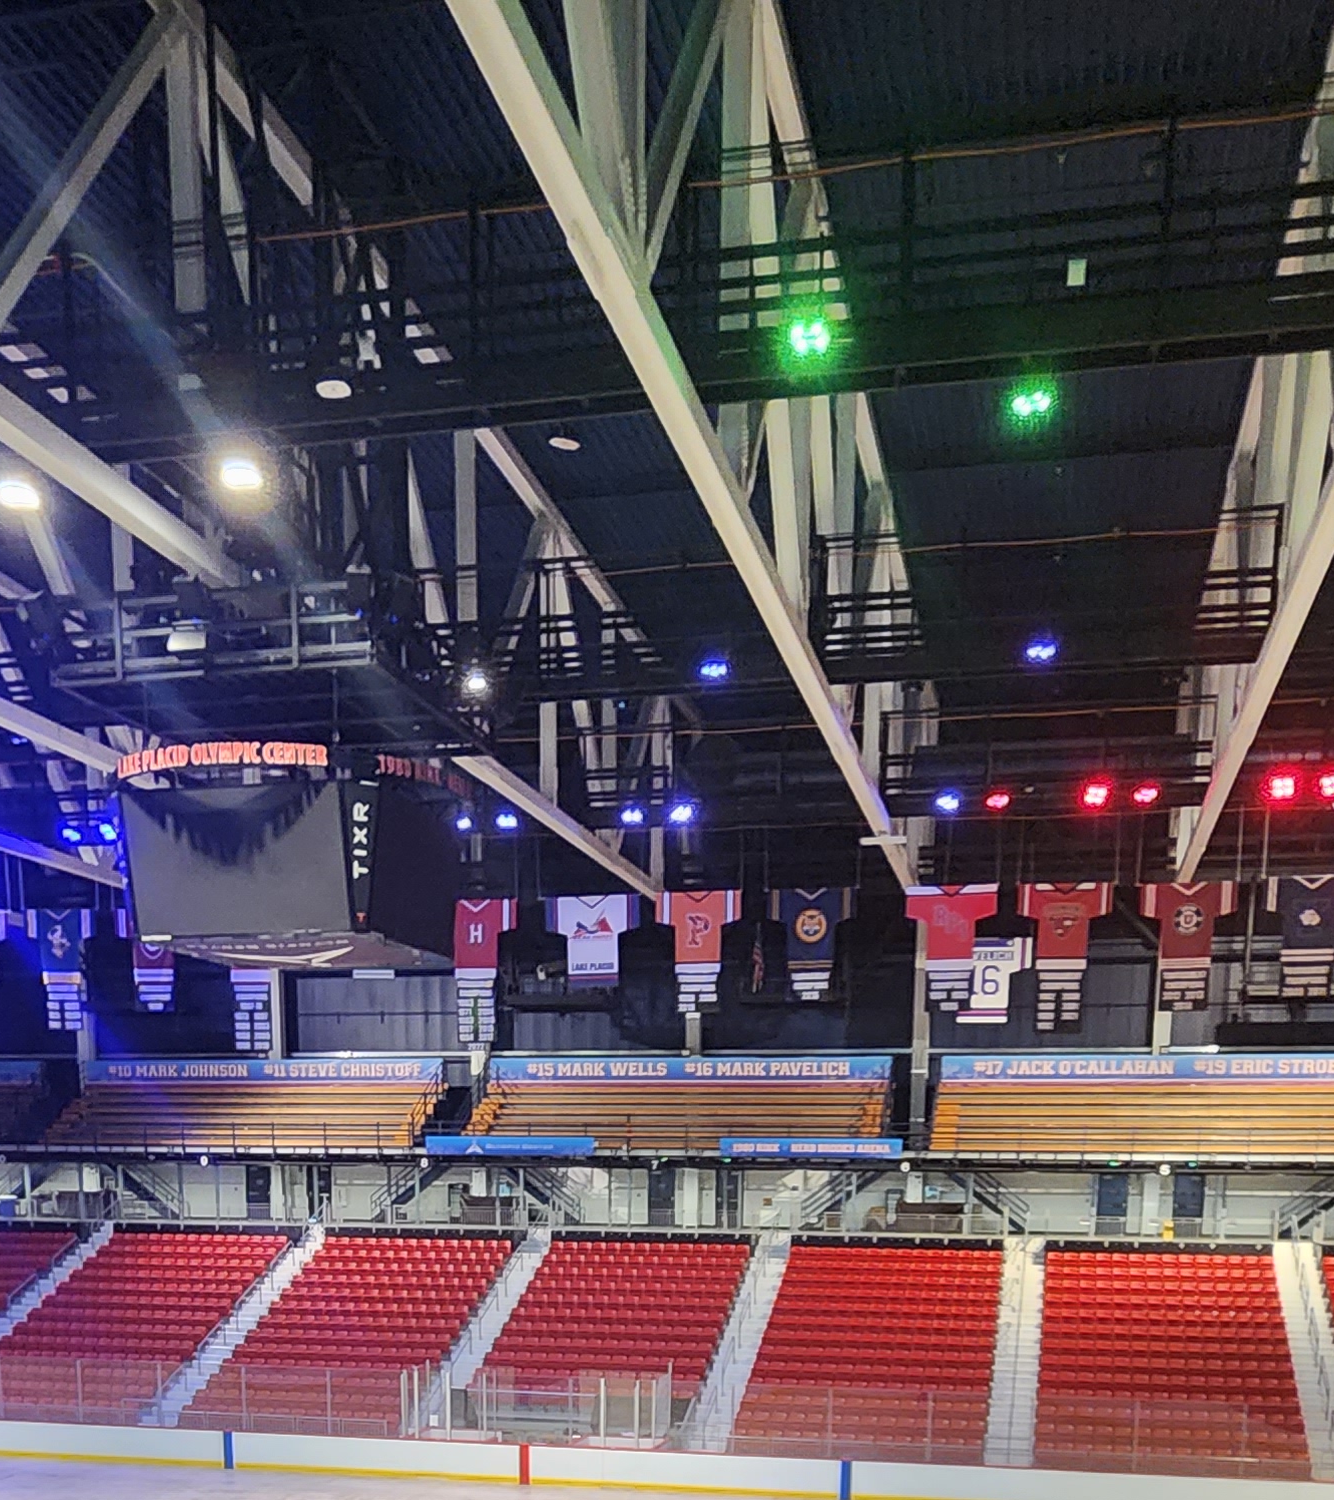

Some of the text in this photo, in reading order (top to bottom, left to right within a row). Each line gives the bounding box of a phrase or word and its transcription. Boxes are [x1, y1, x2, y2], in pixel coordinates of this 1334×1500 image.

[118, 741, 328, 778] LAKE PLACID OLYMPIC CENTER
[352, 802, 370, 879] TIXR
[108, 1064, 248, 1078] #10 MARK JOHNSON
[263, 1063, 421, 1078] #11 STEVE CHRISTOFF
[527, 1061, 668, 1078] #15 MARK WELLS
[684, 1061, 851, 1076] #16 MARK PAVELICH
[973, 1059, 1175, 1077] #17 JACK O'CALLAHAN
[1230, 1059, 1273, 1075] ERIC
